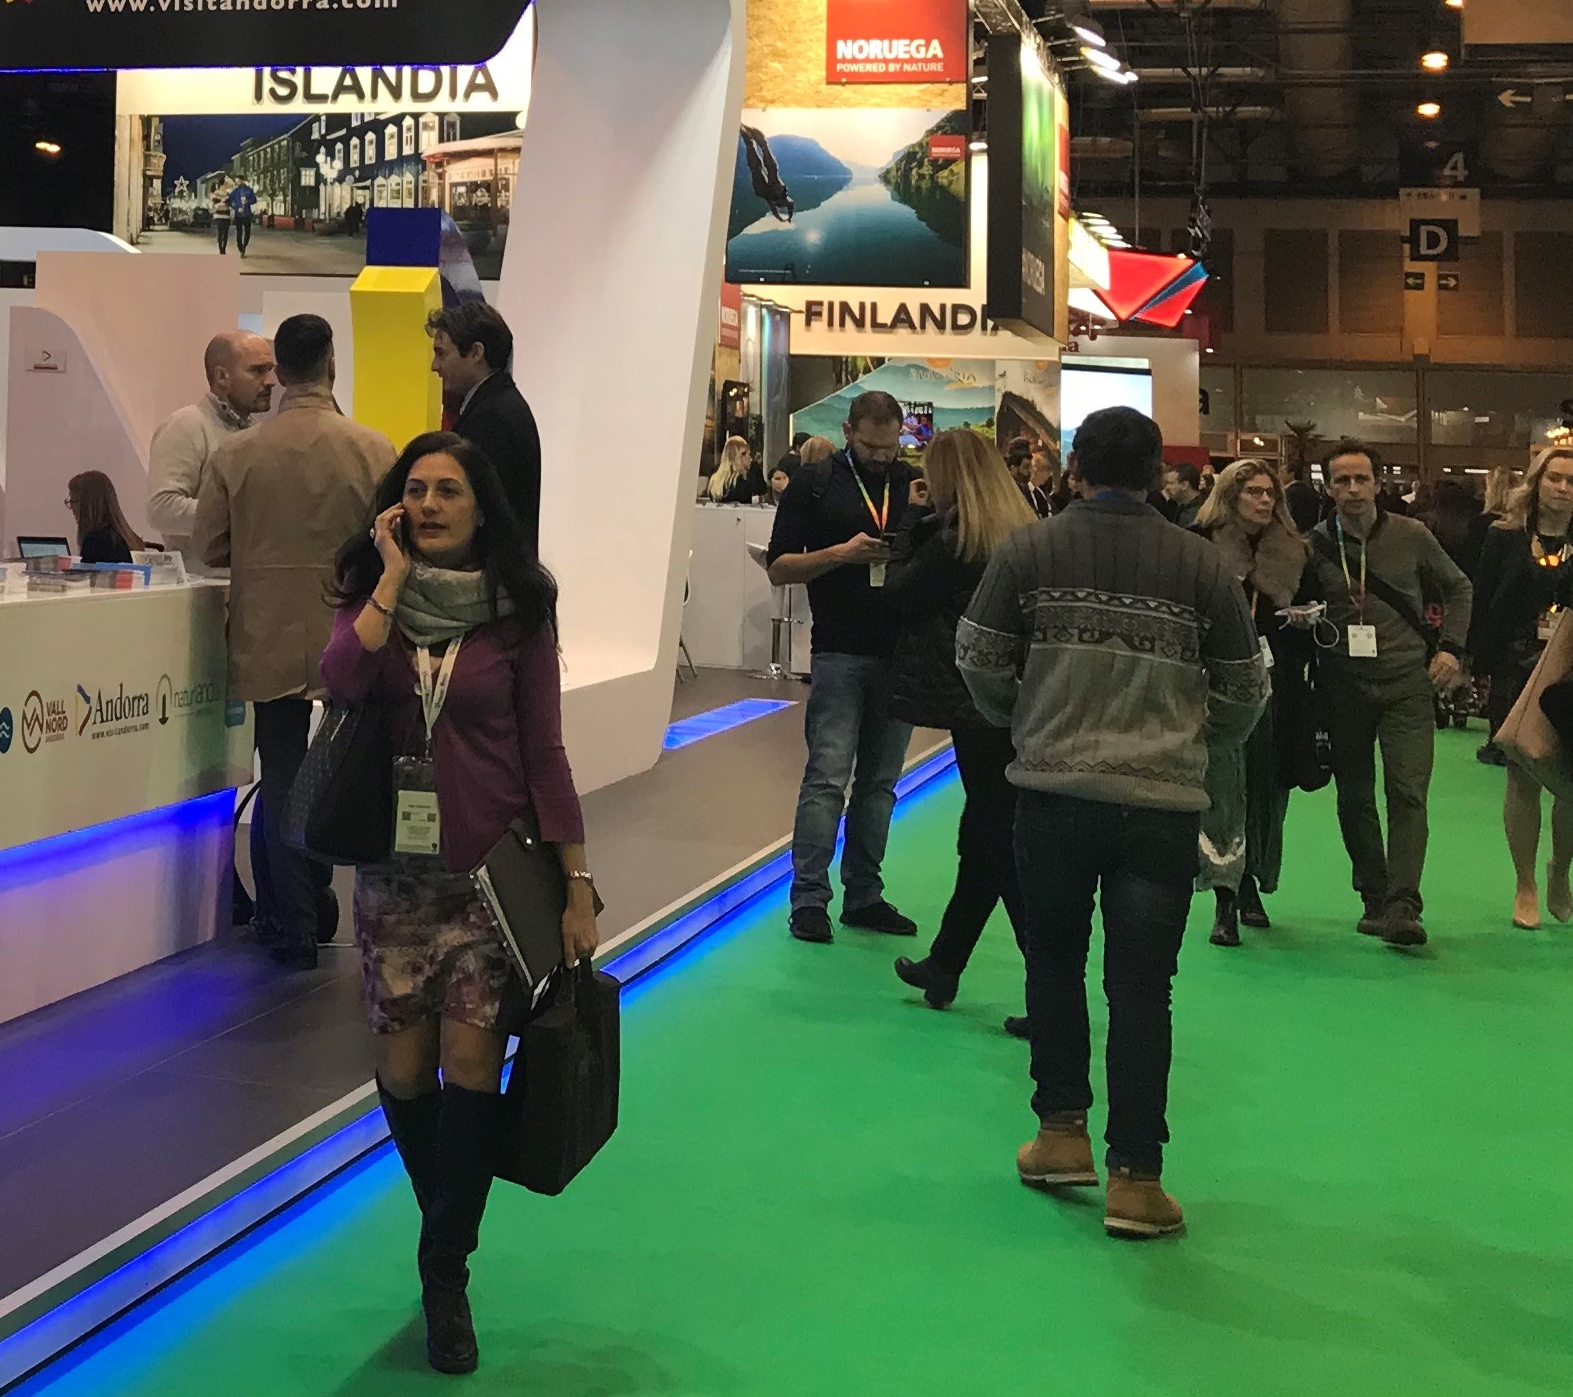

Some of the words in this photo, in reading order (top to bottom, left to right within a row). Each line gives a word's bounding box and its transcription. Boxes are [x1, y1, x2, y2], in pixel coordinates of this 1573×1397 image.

[836, 38, 944, 60] NORUEGA
[836, 62, 886, 73] POWERED
[888, 62, 902, 73] BY
[903, 62, 944, 73] NATURE
[253, 65, 500, 104] ISLANDIA
[1443, 151, 1469, 183] 4
[1419, 224, 1449, 256] D
[46, 699, 66, 717] VALL
[91, 682, 150, 726] Andorra
[45, 715, 69, 734] NORD
